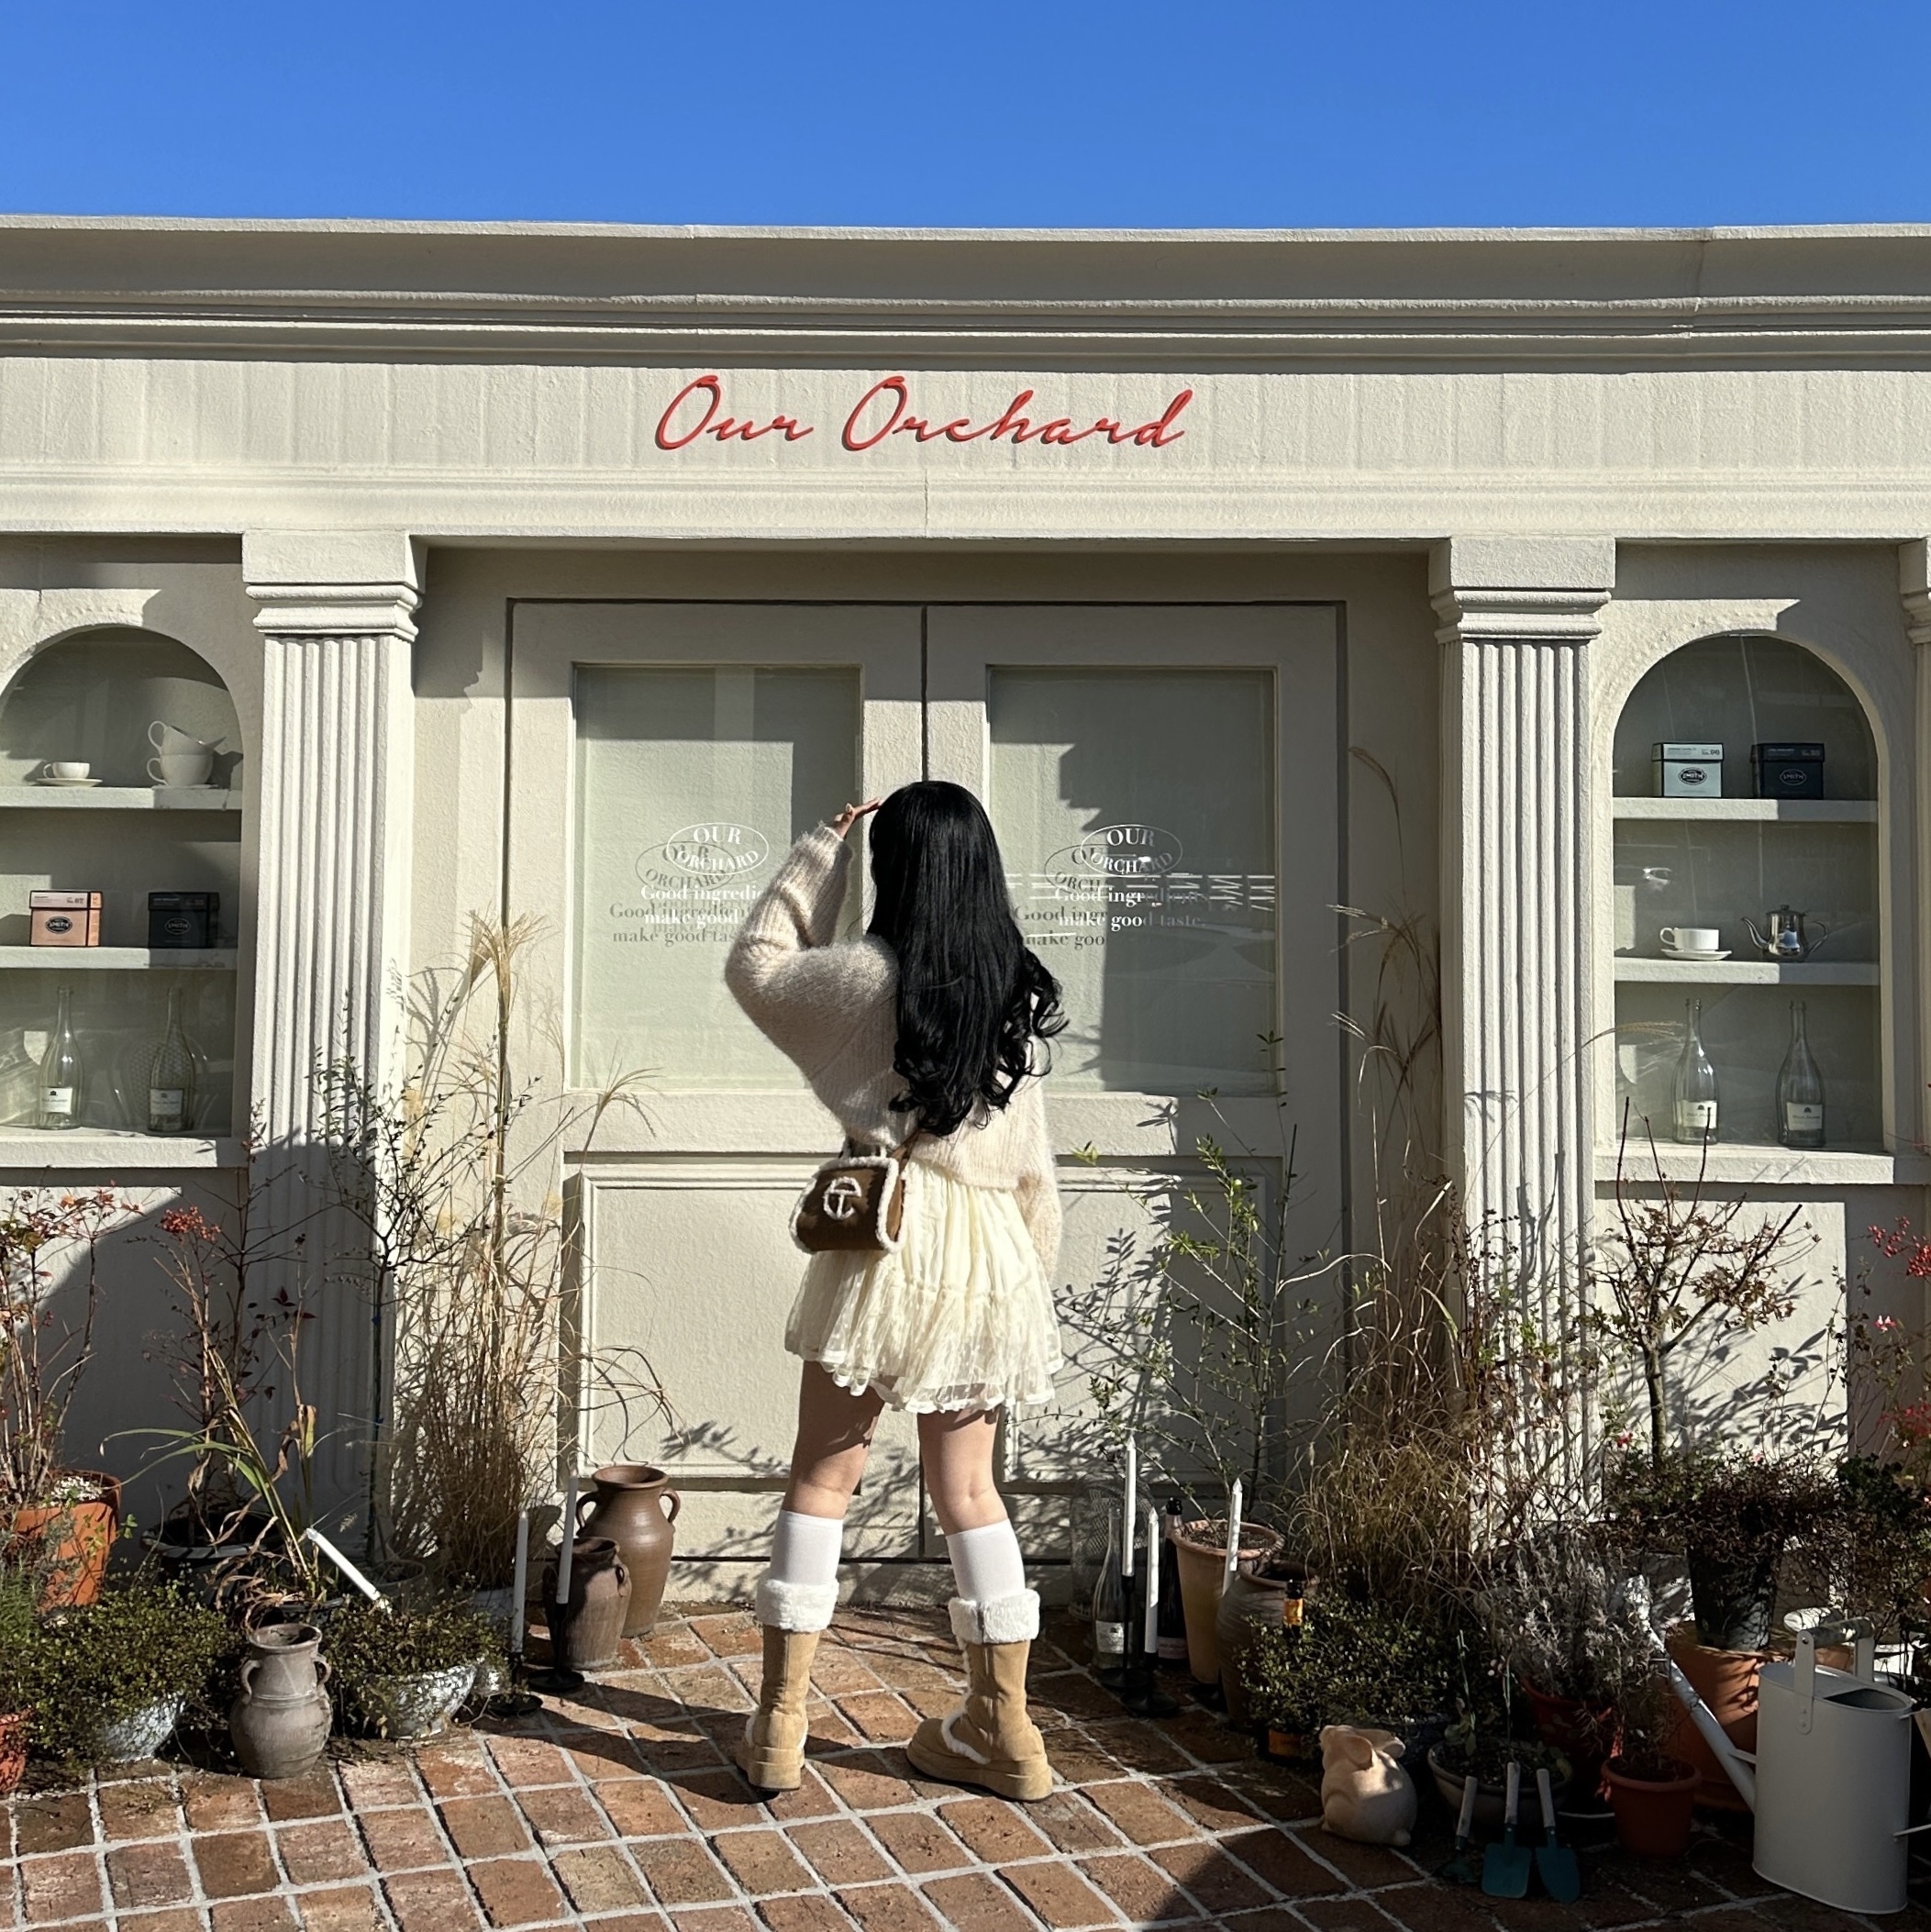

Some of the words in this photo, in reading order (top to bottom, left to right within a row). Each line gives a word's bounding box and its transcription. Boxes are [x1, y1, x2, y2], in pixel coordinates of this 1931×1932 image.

[654, 374, 815, 451] Our
[841, 374, 1193, 452] Orchard
[694, 826, 741, 845] OUR
[1106, 827, 1155, 847] OUR
[677, 849, 759, 872] ORCHARD
[1090, 852, 1173, 873] ORCHARD
[640, 883, 688, 900] Good
[1055, 886, 1102, 902] Good
[645, 908, 691, 924] make
[696, 908, 739, 929] good
[1111, 911, 1153, 932] good
